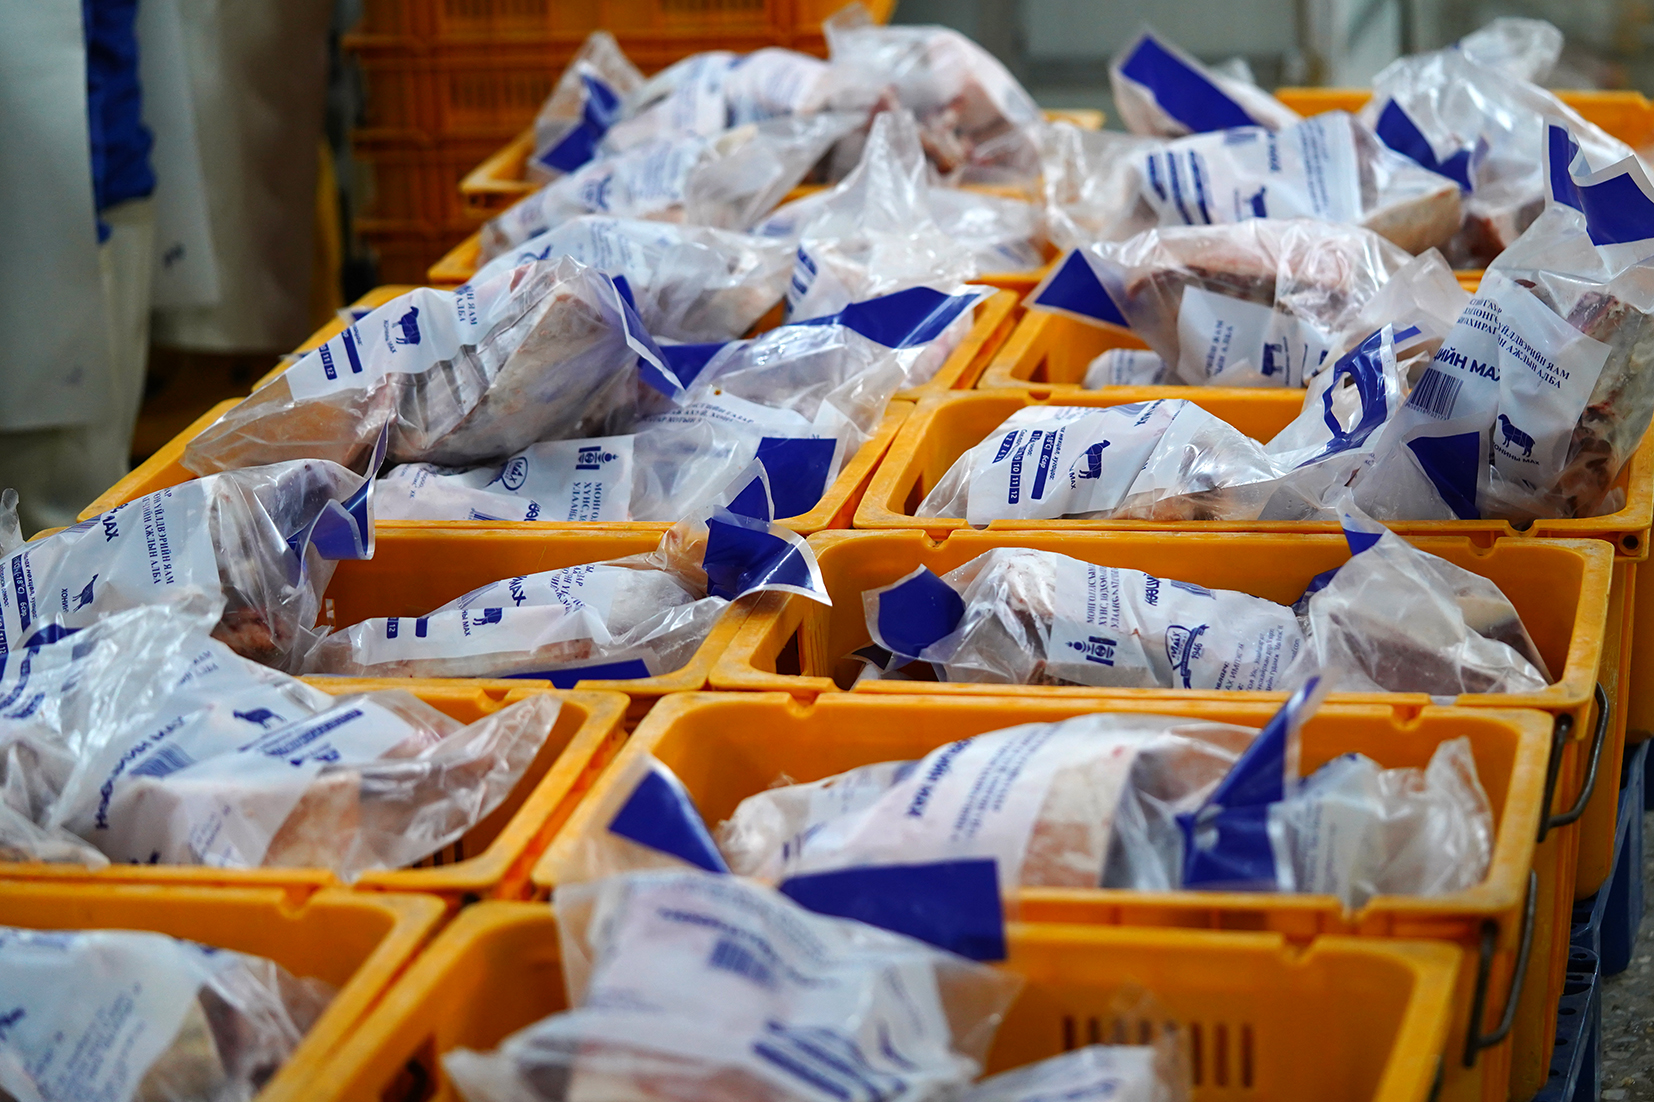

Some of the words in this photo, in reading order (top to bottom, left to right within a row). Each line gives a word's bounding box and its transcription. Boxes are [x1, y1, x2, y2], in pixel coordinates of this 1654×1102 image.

[1506, 346, 1538, 373] АЖЛЫН
[1537, 369, 1561, 389] АЛБА
[1546, 362, 1571, 380] ЯАМ
[145, 524, 158, 558] АЖЛЫН
[152, 505, 172, 562] ҮЙЛДВЭРИЙН
[163, 563, 174, 584] ЯАМ
[151, 560, 161, 584] АЛБА
[1191, 641, 1203, 659] 1946
